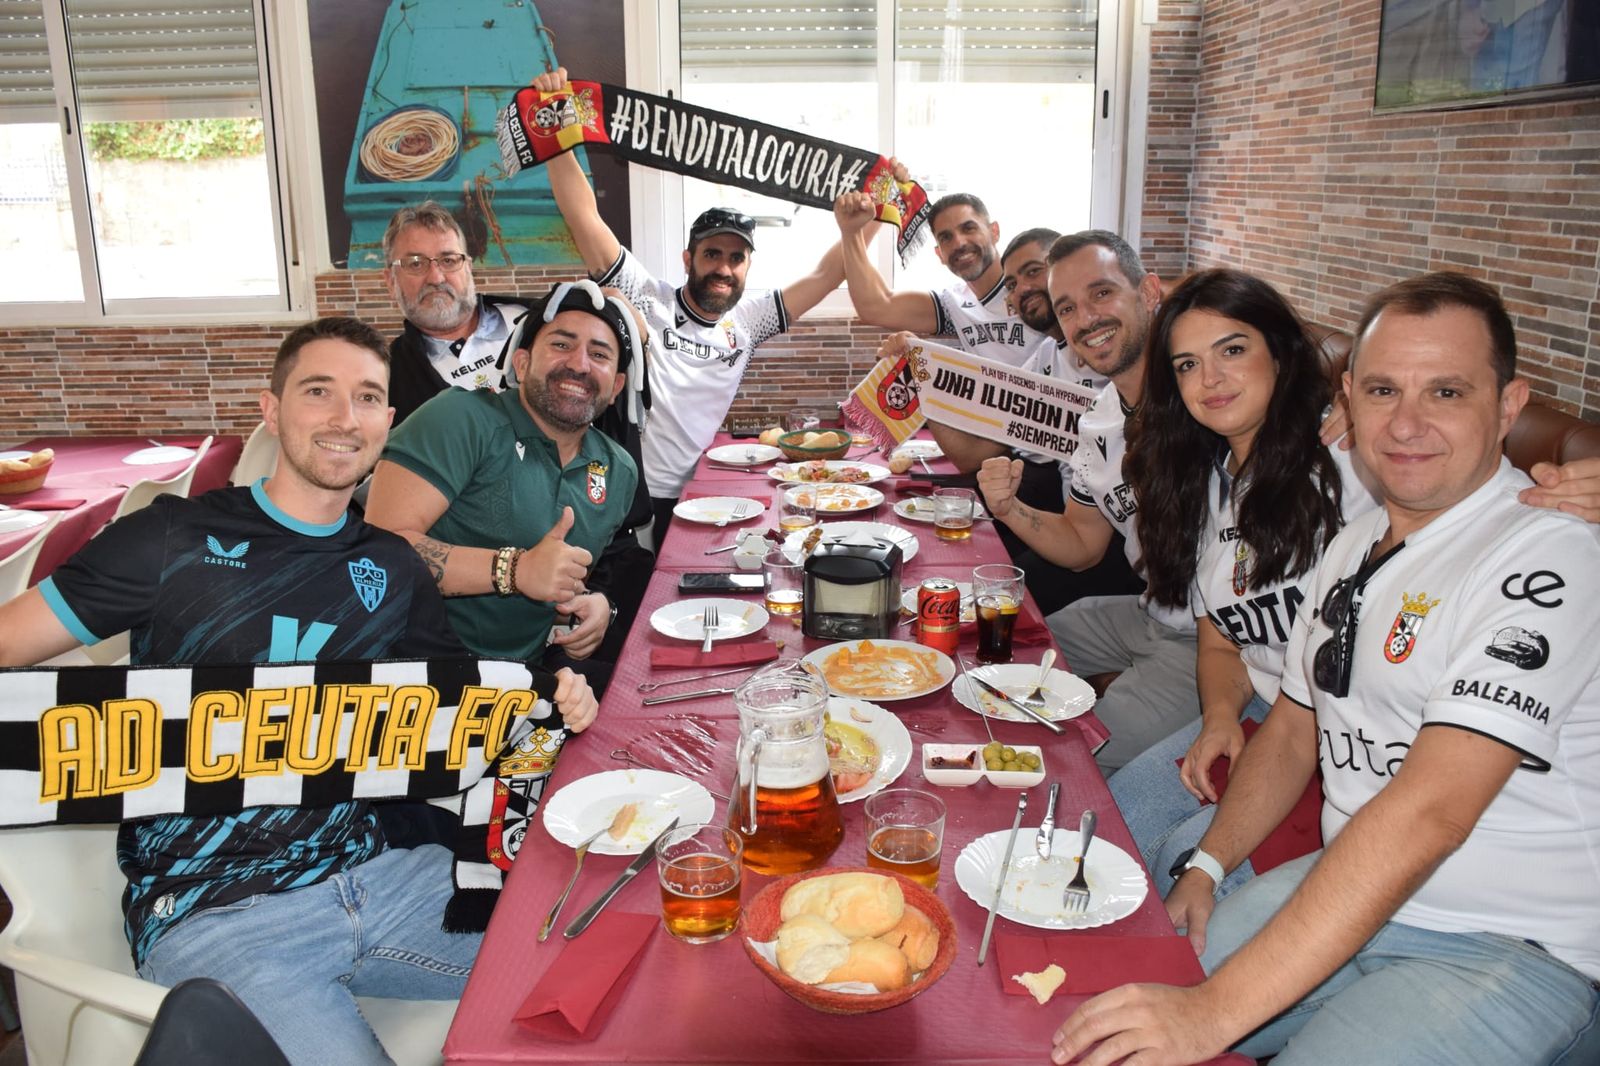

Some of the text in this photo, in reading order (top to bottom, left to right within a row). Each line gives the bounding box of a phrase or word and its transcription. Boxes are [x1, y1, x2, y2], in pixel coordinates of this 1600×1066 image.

[508, 102, 533, 165] AD CEUTA FC
[610, 94, 868, 202] #BENDITALOCURA#
[904, 214, 922, 241] CEUTA
[919, 203, 932, 217] FC
[450, 354, 496, 379] KELME
[1008, 374, 1036, 391] ASCENSO
[1039, 382, 1056, 397] LIGA
[932, 367, 976, 401] UNA
[979, 382, 1063, 430] ILUSIÓN
[204, 556, 247, 569] CASTORE
[1451, 679, 1550, 725] BALEARIA
[38, 683, 539, 804] AD CEUTA FC
[1318, 727, 1411, 777] uta
